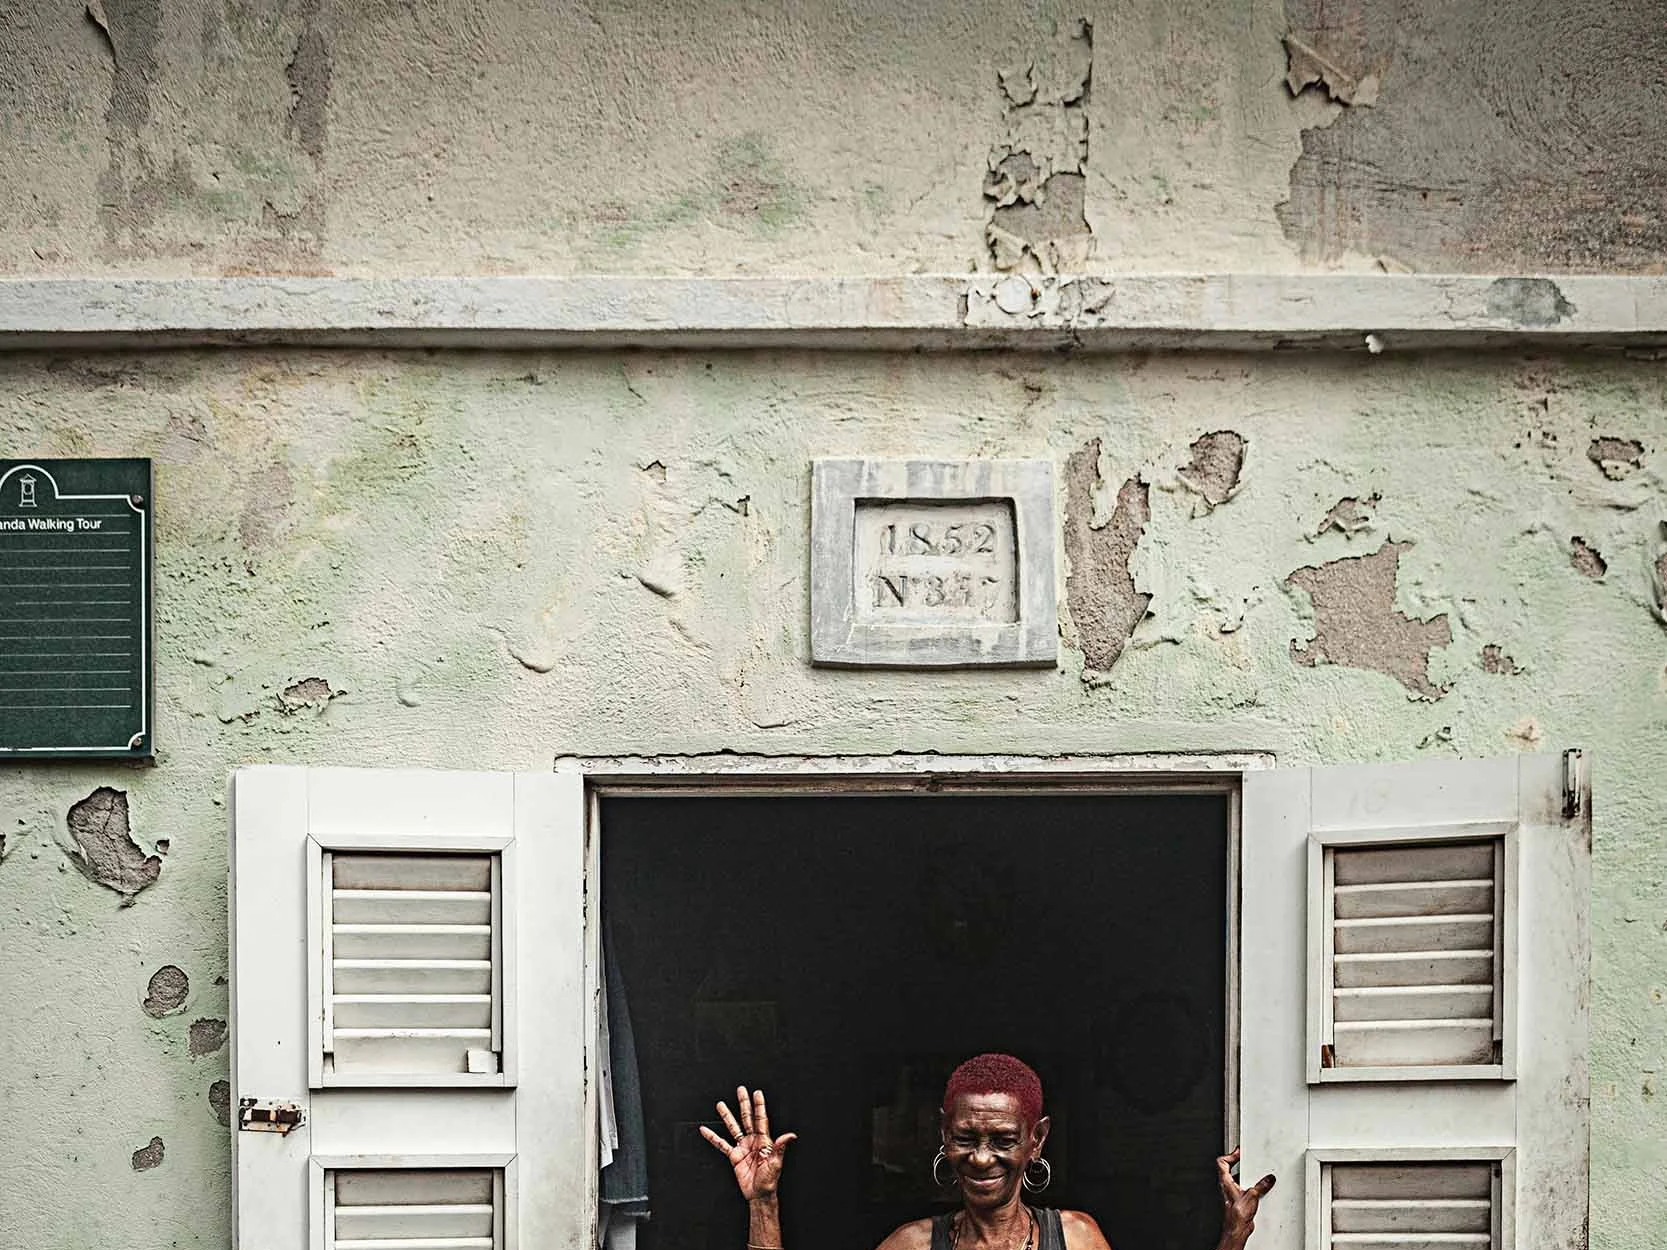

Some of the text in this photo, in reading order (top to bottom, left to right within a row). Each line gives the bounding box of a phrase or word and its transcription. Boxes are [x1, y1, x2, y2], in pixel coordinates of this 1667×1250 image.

[27, 518, 75, 532] Walking
[76, 518, 102, 530] Tour
[881, 522, 998, 557] 1852
